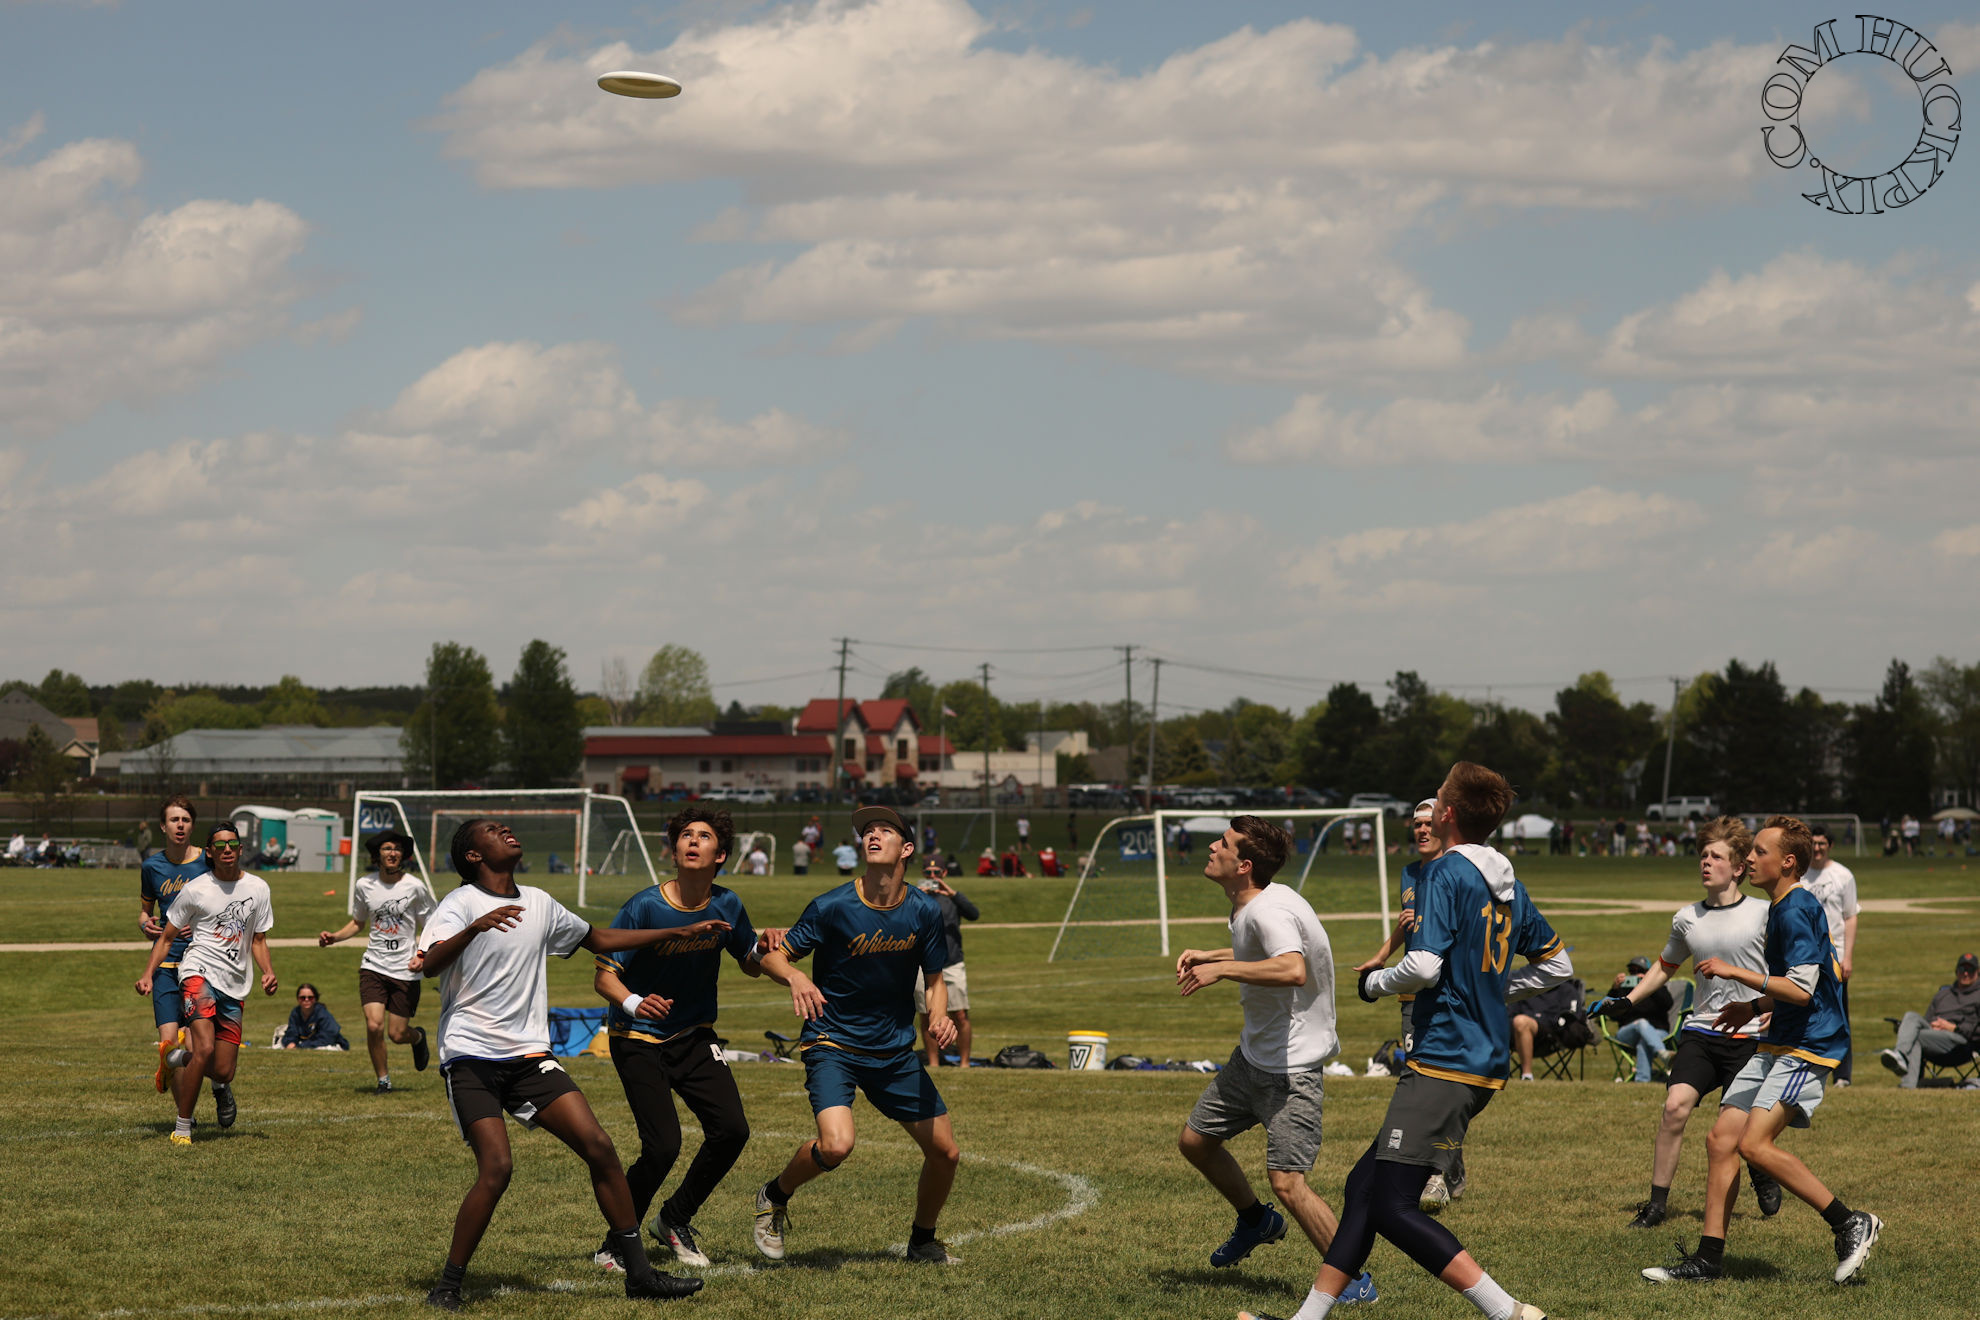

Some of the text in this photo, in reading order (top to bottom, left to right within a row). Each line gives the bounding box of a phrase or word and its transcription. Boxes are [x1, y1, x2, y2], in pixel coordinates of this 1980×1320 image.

[360, 807, 394, 829] 202
[848, 929, 916, 956] Wildcats
[1481, 901, 1512, 975] 13
[1405, 1033, 1413, 1052] 6
